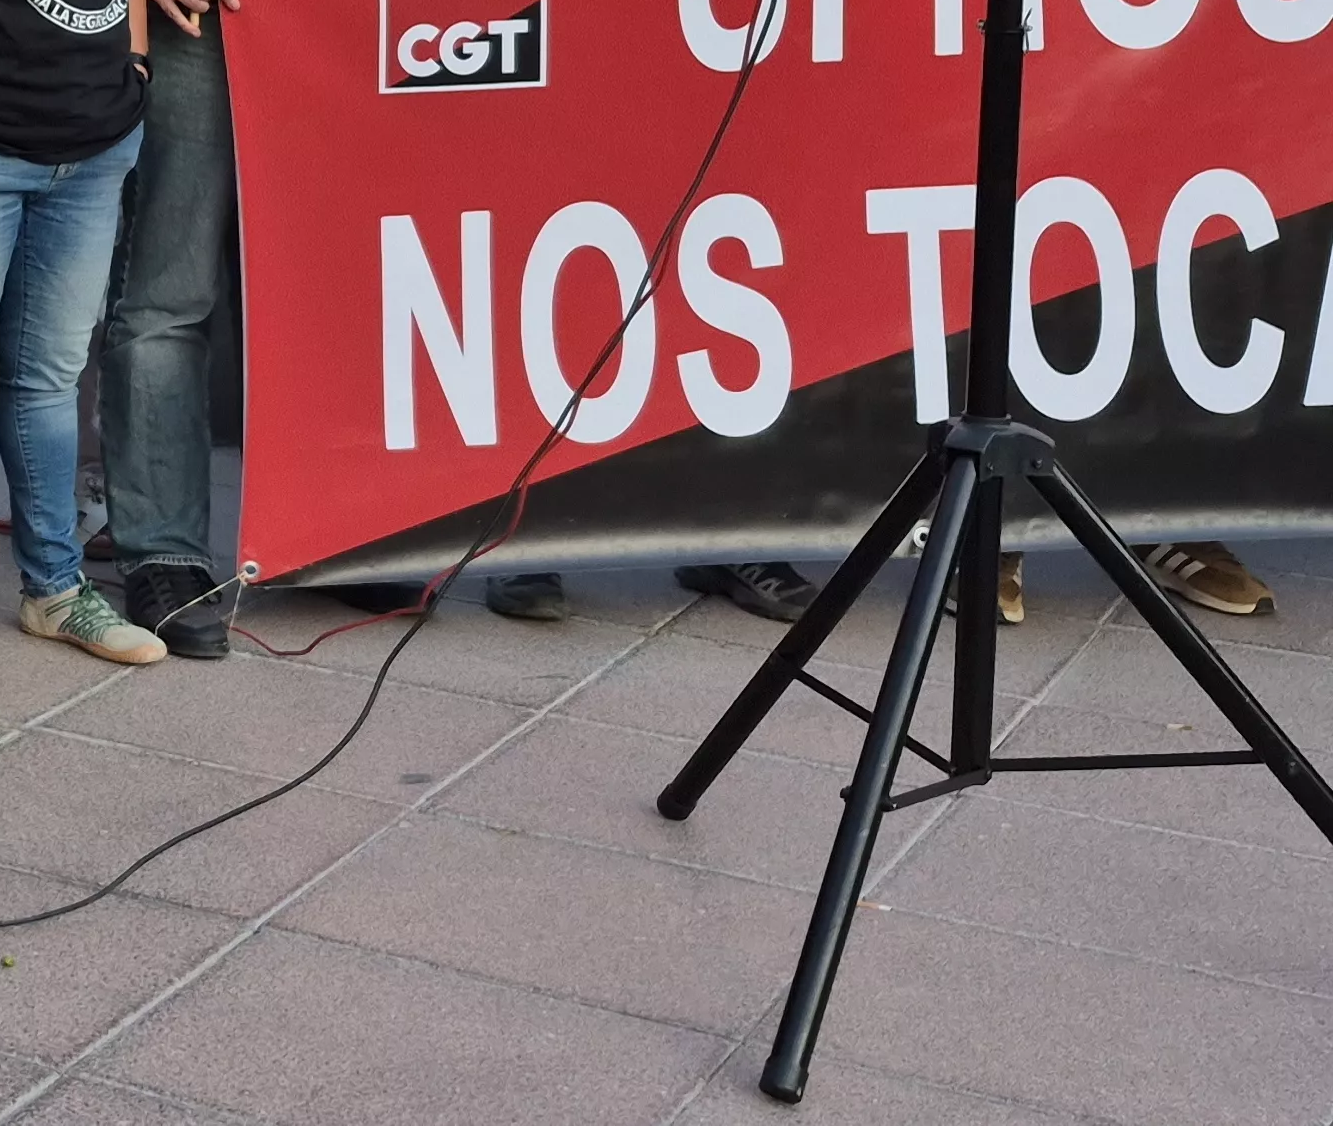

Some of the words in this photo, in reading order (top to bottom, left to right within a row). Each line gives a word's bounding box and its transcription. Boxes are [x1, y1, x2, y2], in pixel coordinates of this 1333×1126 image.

[51, 3, 70, 25] LA
[396, 18, 530, 79] CGT
[379, 193, 794, 451] NOS
[865, 168, 1333, 424] TOC
